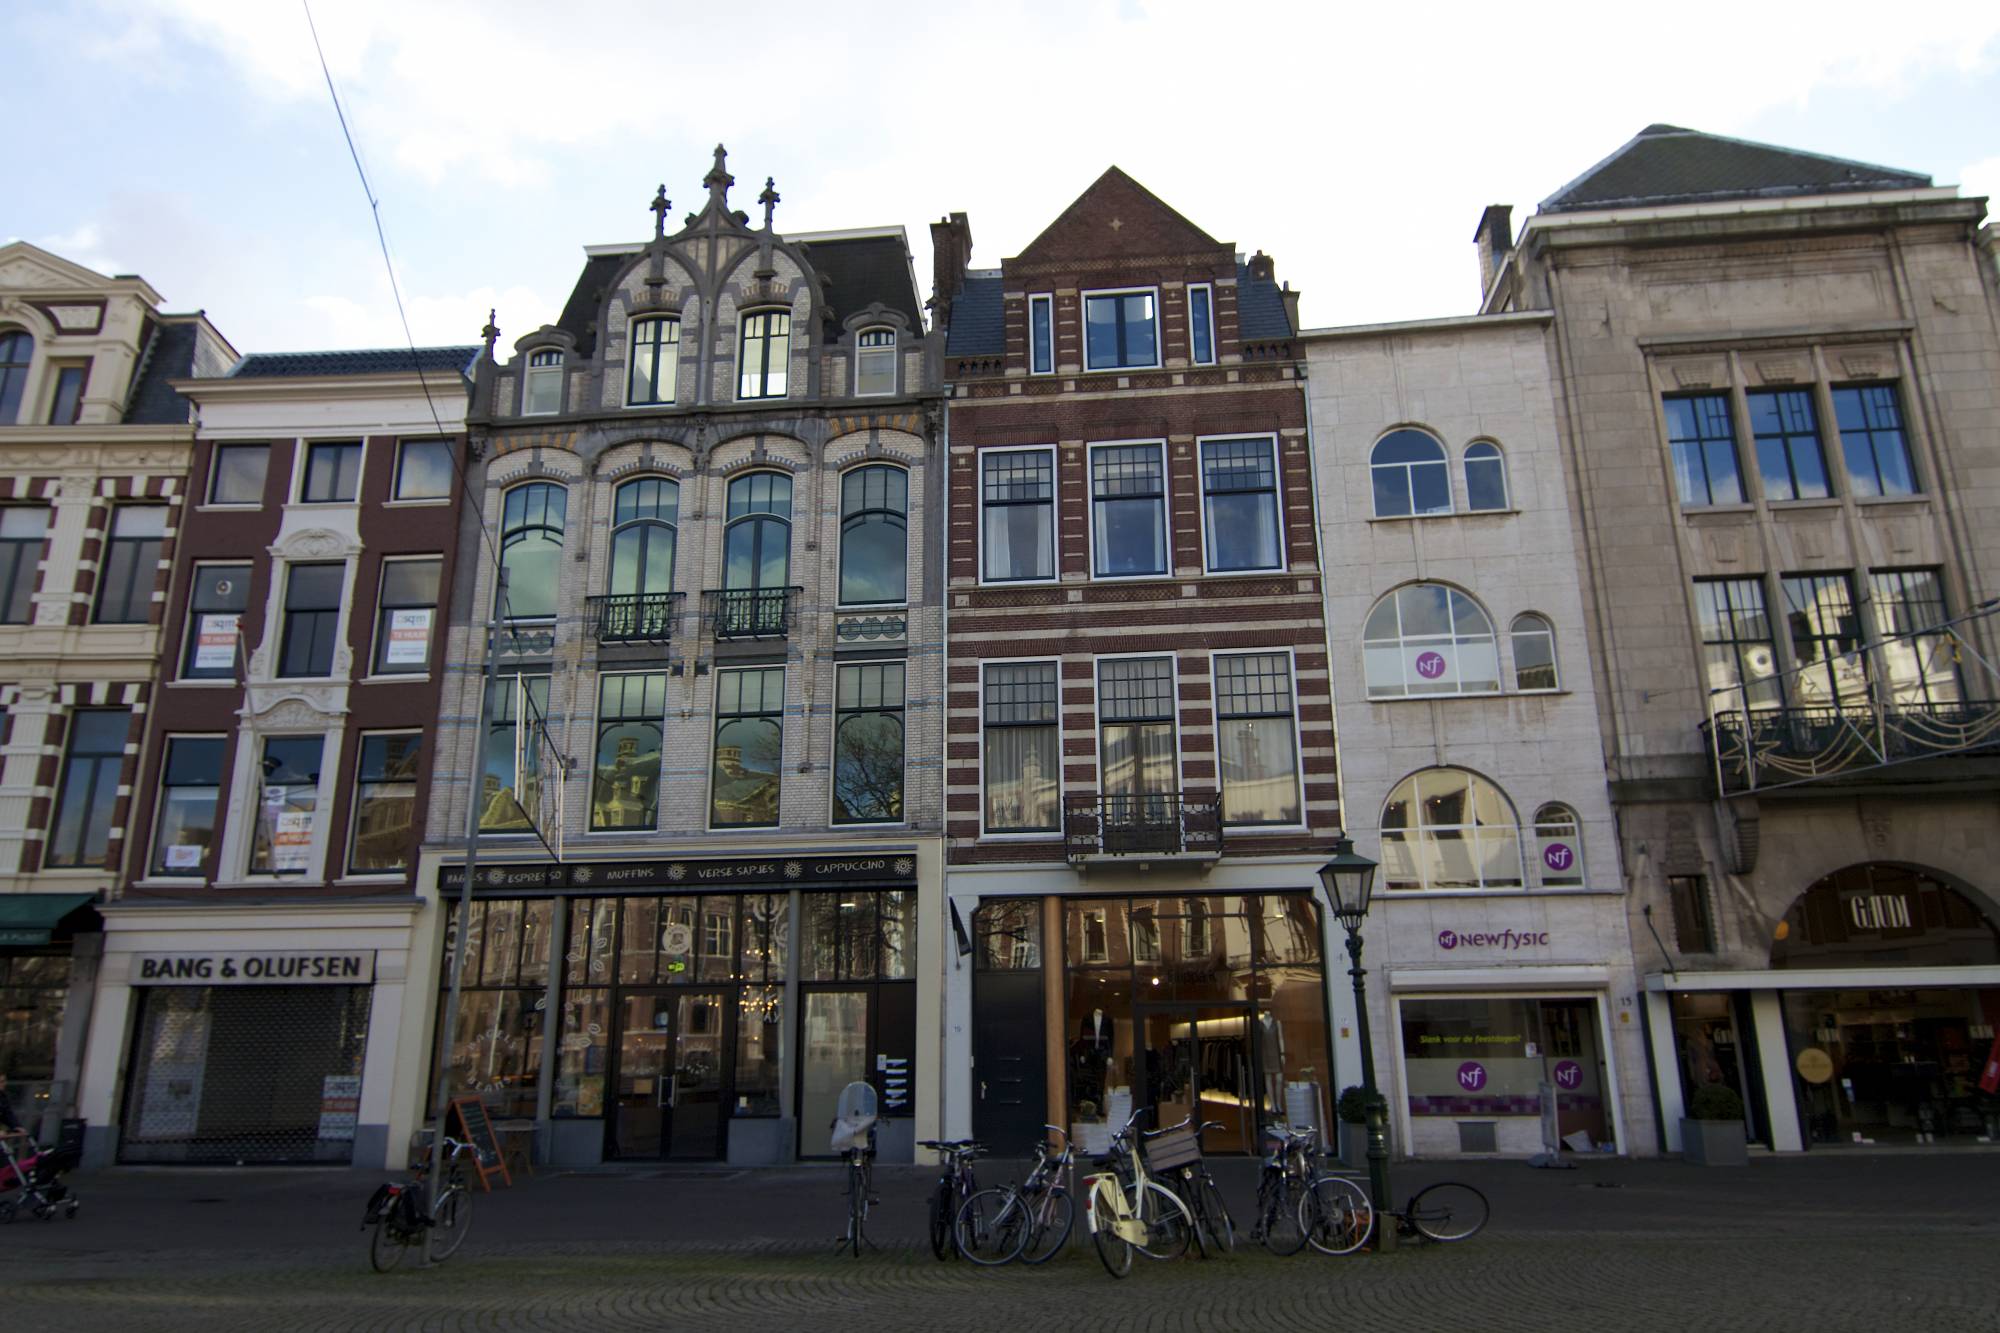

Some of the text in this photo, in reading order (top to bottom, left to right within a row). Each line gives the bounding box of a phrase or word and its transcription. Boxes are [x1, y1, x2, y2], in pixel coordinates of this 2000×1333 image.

[607, 867, 656, 881] MUFFINS
[697, 864, 775, 879] VERSE SAPJES
[815, 860, 886, 874] CAPPUCCINO
[507, 870, 563, 884] ESPRESSO
[1851, 894, 1912, 929] GAUDI
[141, 956, 361, 979] BANG & OLUFSEN
[1620, 997, 1633, 1007] 15
